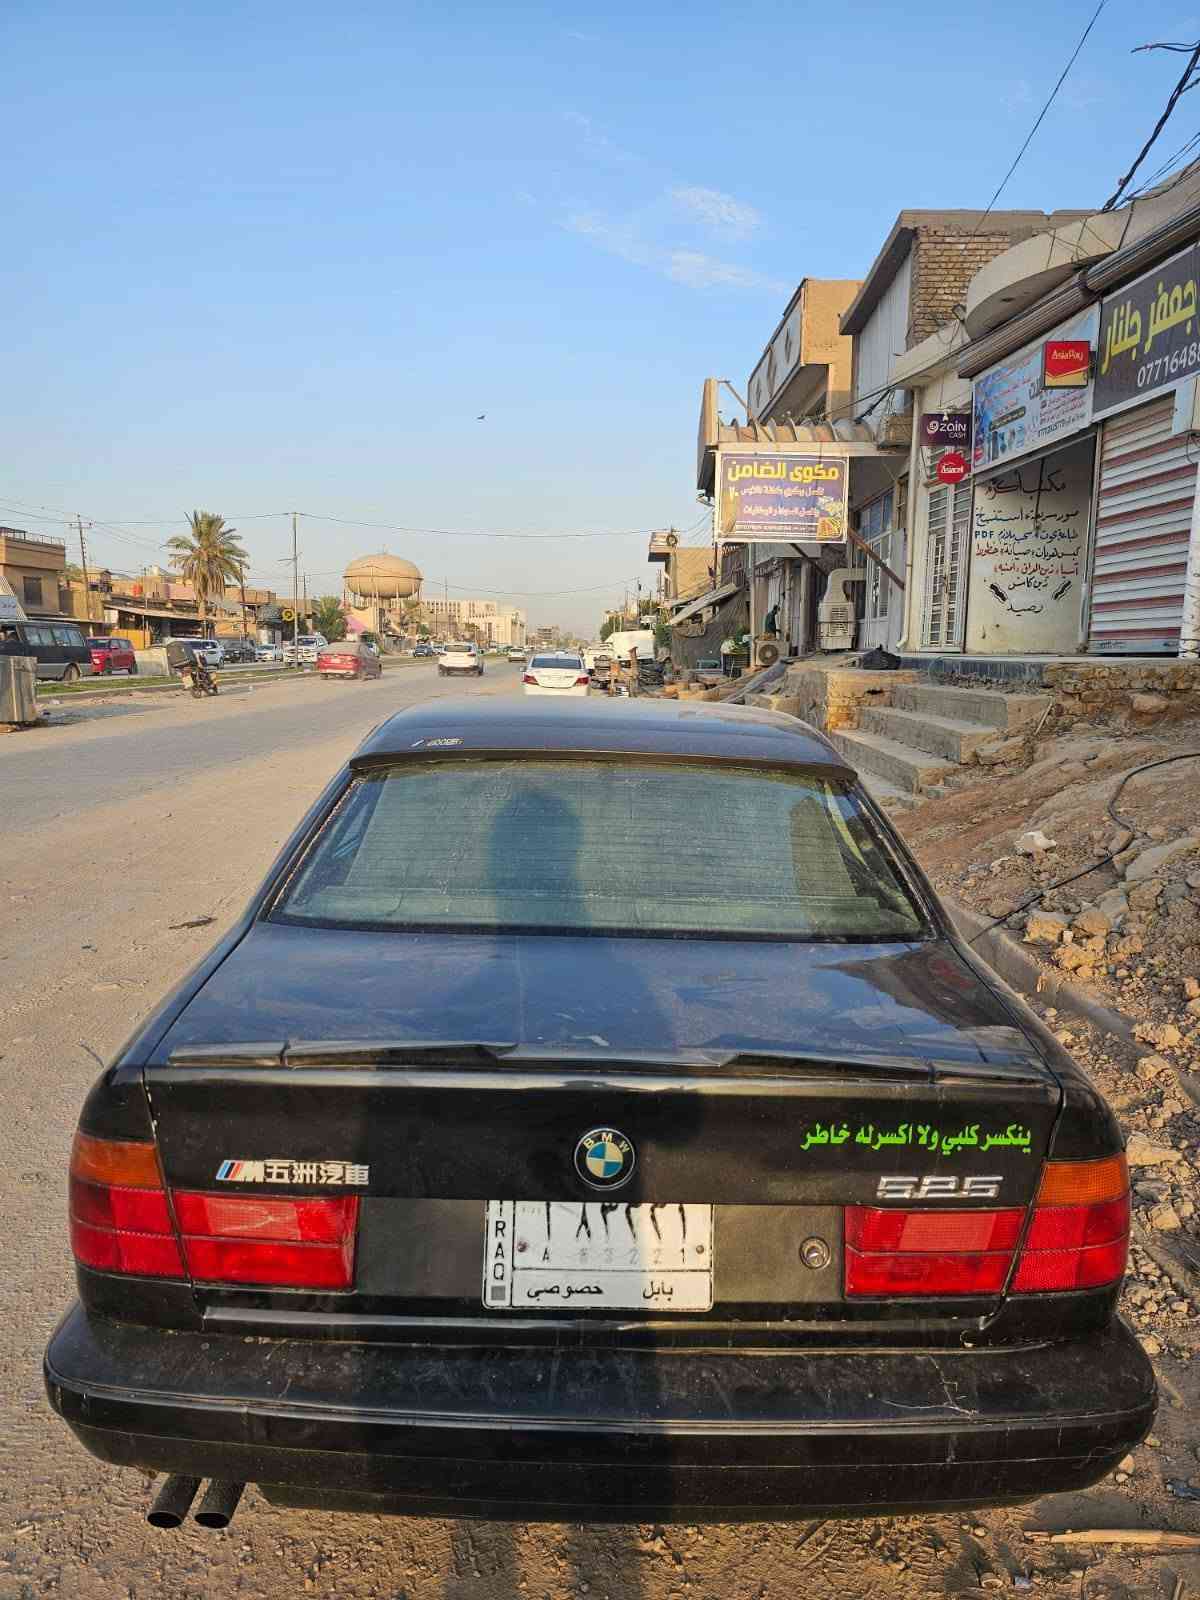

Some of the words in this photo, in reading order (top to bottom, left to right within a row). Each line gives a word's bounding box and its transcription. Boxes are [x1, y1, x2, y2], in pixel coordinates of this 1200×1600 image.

[1144, 280, 1197, 354] جعفر
[1101, 300, 1142, 375] جلنار
[727, 460, 786, 481] الضامن
[975, 530, 995, 539] PDF
[1007, 603, 1044, 617] رصيد
[583, 1132, 630, 1154] BMW
[799, 1121, 851, 1151] خاطر
[917, 1123, 939, 1151] ولا
[940, 1123, 981, 1156] كلبي
[979, 1123, 1032, 1153] ينكسر
[876, 1175, 1004, 1199] 525
[493, 1201, 507, 1281] IRAQ
